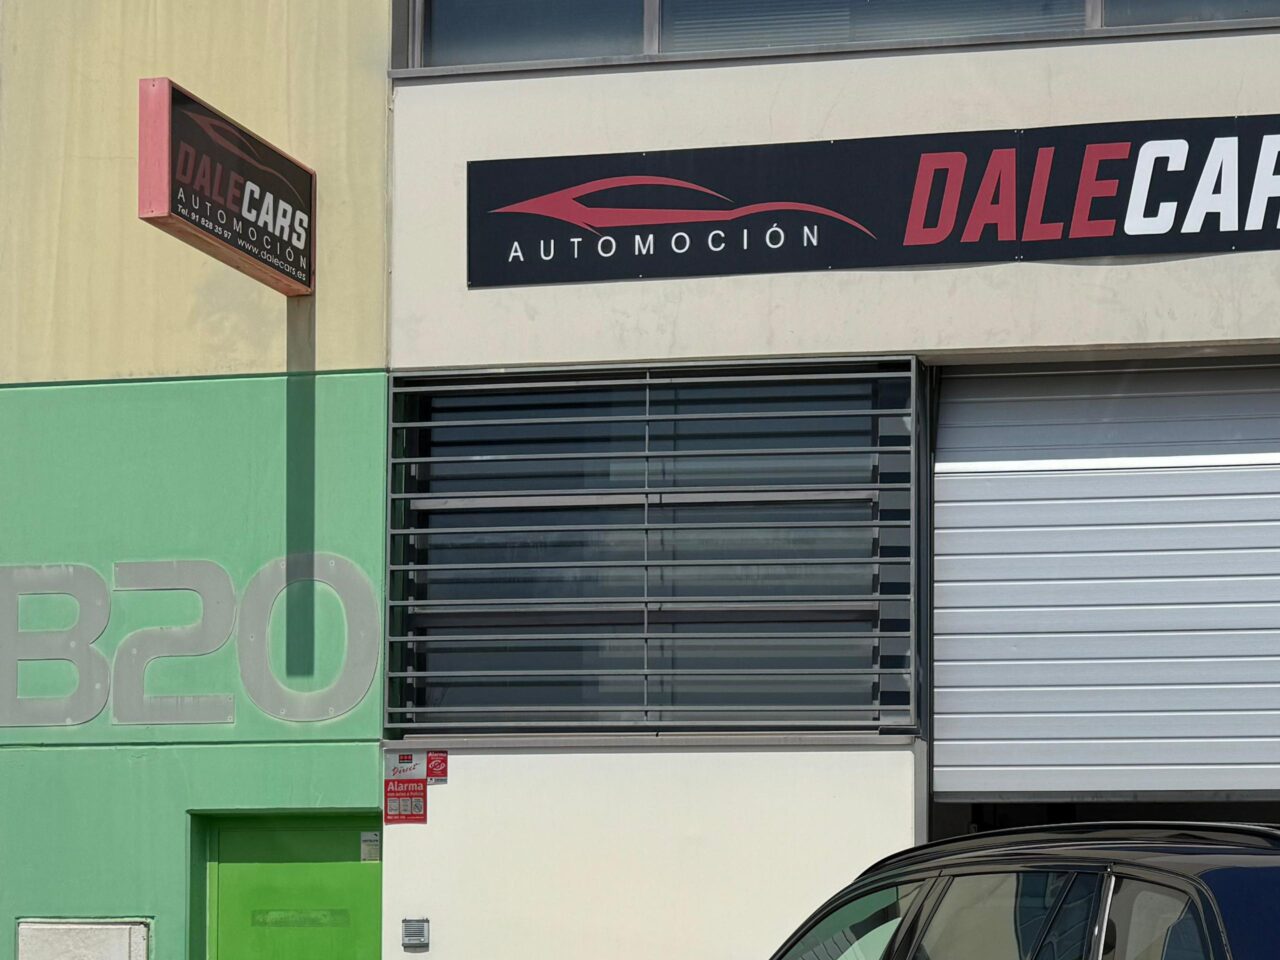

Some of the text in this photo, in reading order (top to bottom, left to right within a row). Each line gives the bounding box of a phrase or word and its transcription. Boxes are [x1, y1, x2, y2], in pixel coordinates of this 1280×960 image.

[175, 140, 308, 250] DALECARS
[177, 187, 307, 269] AUTOMOCIÓN
[191, 212, 199, 222] 91
[200, 217, 213, 230] 828
[214, 224, 223, 235] 35
[223, 230, 232, 240] 97
[237, 238, 306, 281] www.dalecars.es
[508, 223, 819, 262] AUTOMOCIÓN
[0, 551, 381, 727] B20
[387, 781, 424, 791] Alarma
